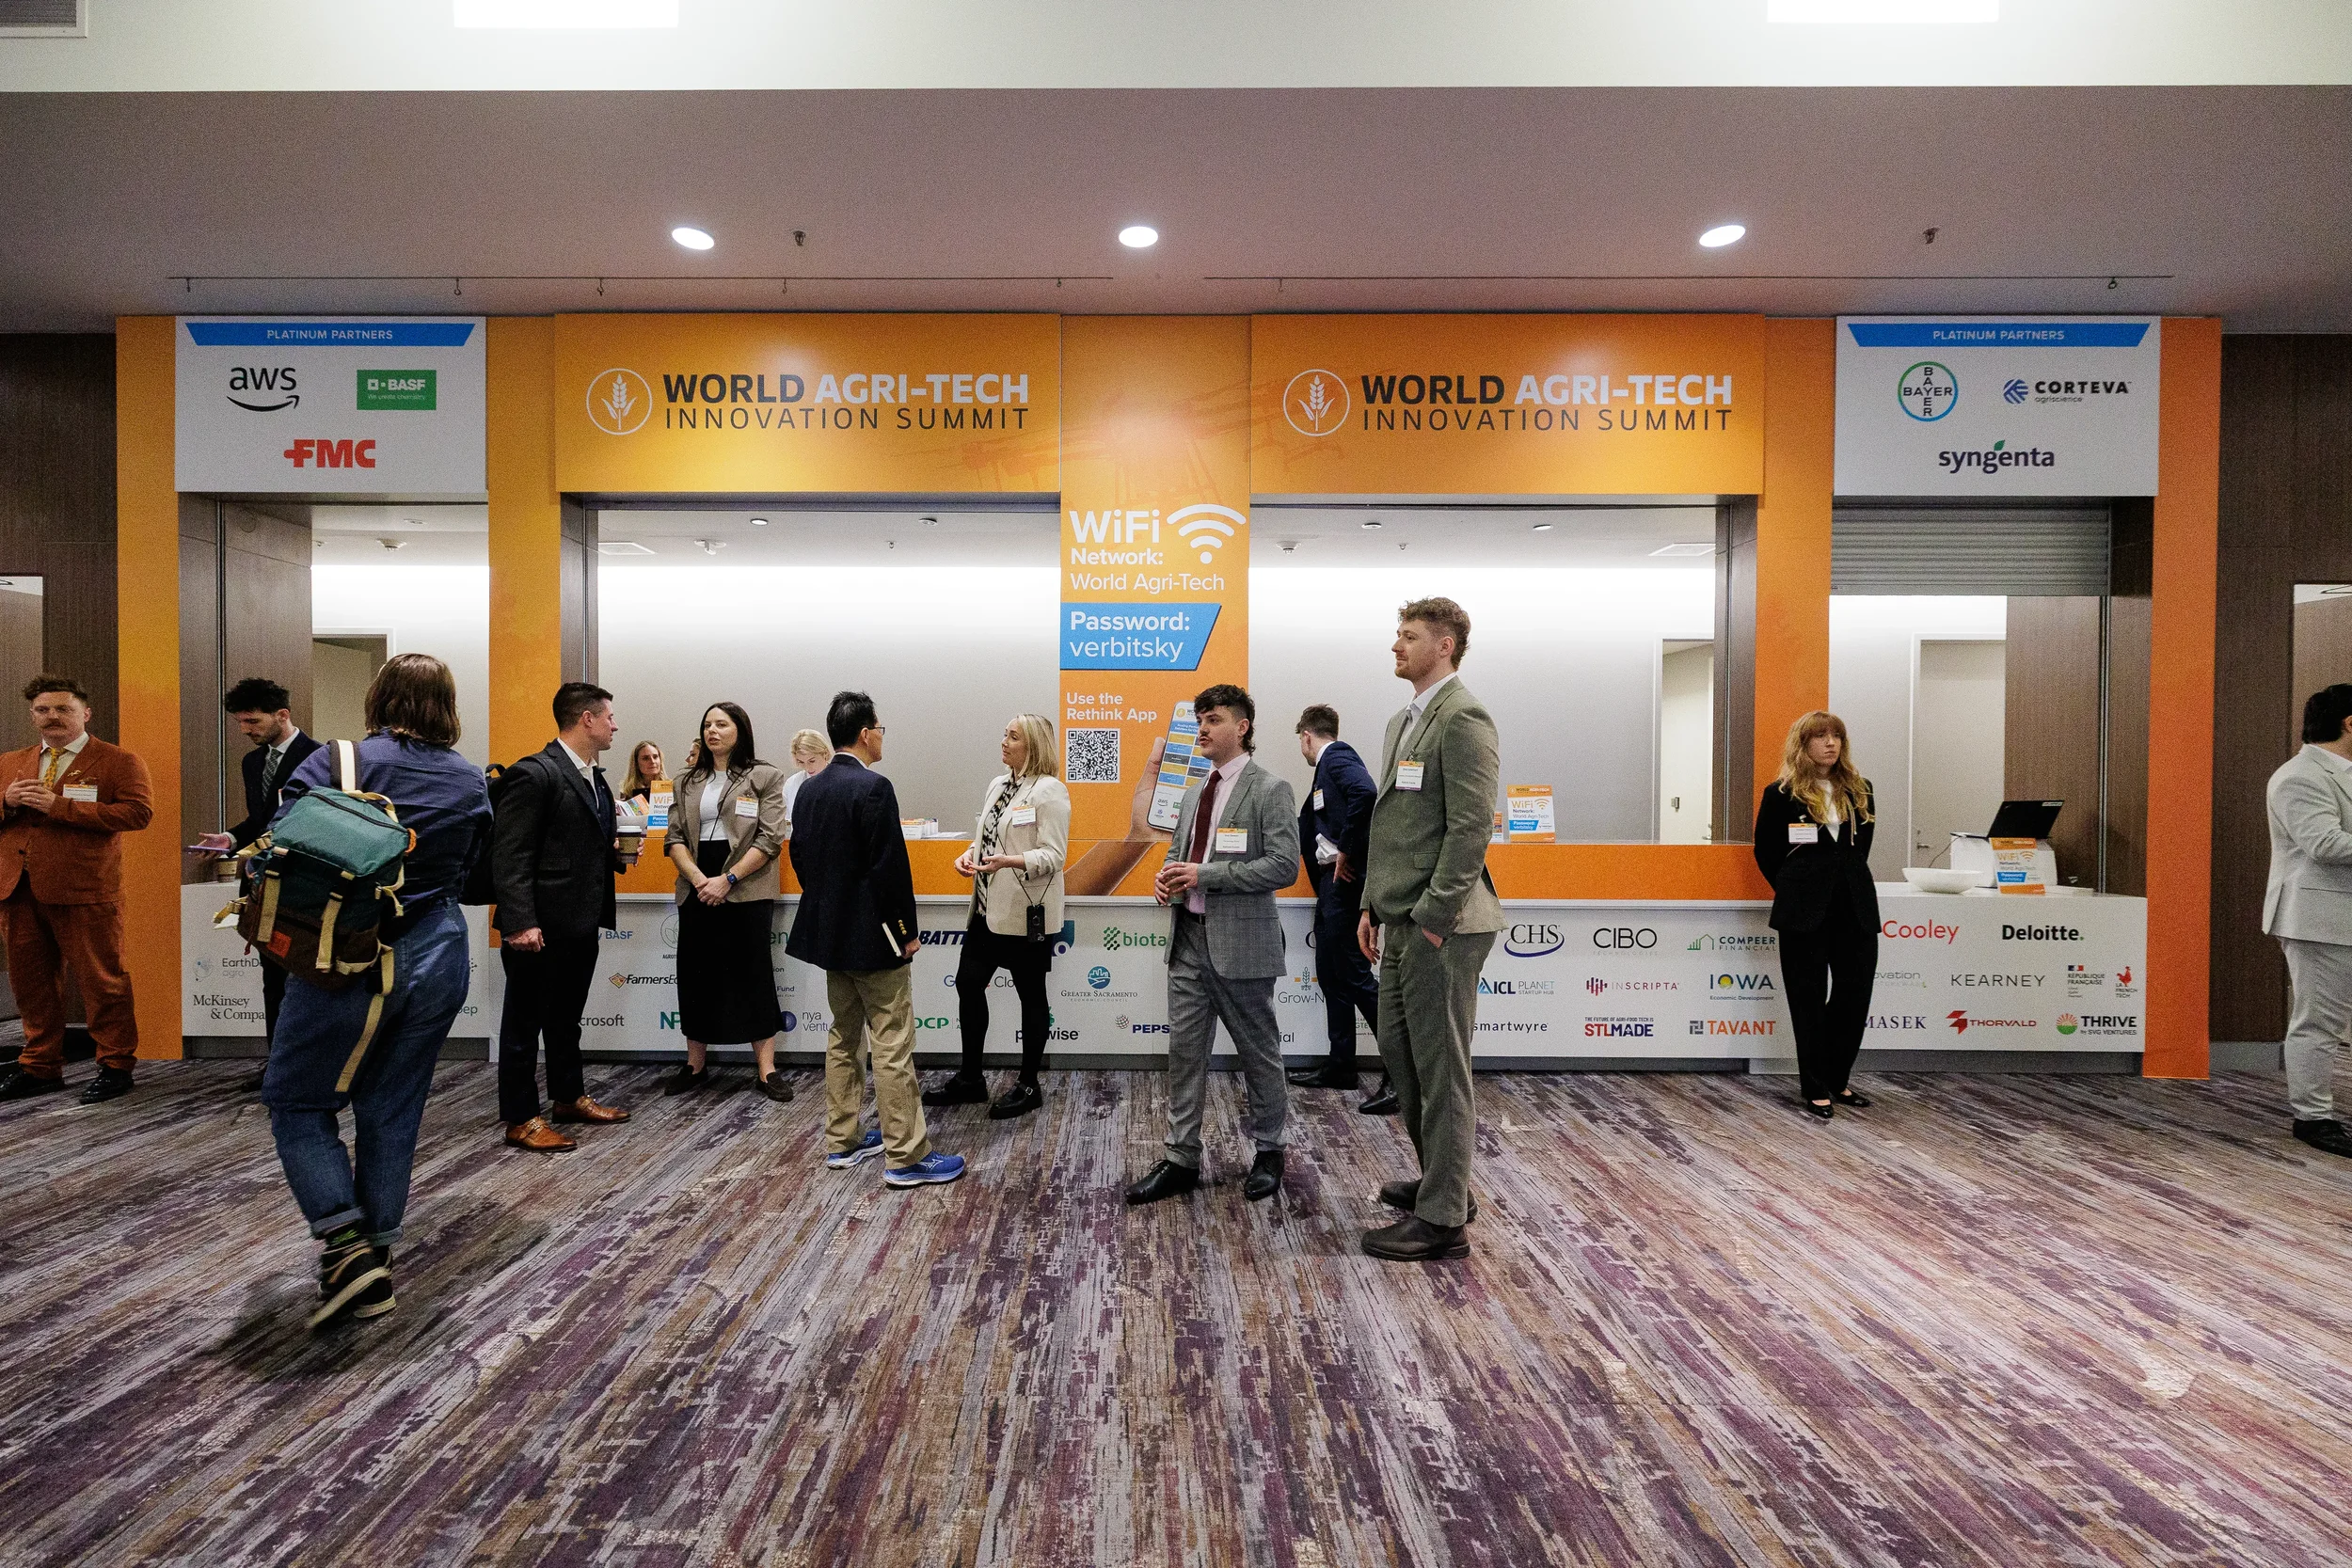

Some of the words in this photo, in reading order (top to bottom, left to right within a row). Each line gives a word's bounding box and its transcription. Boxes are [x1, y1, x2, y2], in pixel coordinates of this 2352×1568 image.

[267, 329, 327, 340] PLATINUM
[331, 329, 393, 340] PARTNERS
[1933, 330, 1995, 340] PLATINUM
[2000, 330, 2065, 340] PARTNERS
[229, 367, 297, 391] aws
[388, 379, 426, 390] BASF
[663, 373, 804, 404] WORLD
[815, 373, 1028, 404] AGRI-TECH
[1361, 374, 1505, 404] WORLD
[1515, 374, 1732, 404] AGRI-TECH
[1903, 387, 1953, 396] BAYER
[2035, 381, 2129, 394] CORTEVA
[666, 407, 879, 429] INNOVATION
[897, 407, 1029, 429] SUMMIT
[1364, 409, 1580, 431] INNOVATION
[1598, 409, 1732, 431] SUMMIT
[284, 439, 375, 468] FMC
[1938, 447, 2055, 473] syngenta
[1069, 510, 1160, 544] WiFi
[1071, 548, 1163, 565] Network:
[1071, 573, 1127, 591] World
[1134, 573, 1225, 594] Agri-Tech
[1071, 611, 1190, 631] Password:
[1070, 638, 1184, 662] verbitsky
[1066, 692, 1095, 705] Use
[1100, 692, 1123, 705] the
[1066, 707, 1122, 721] Rethink
[1127, 707, 1157, 724] App
[606, 931, 633, 940] BASF
[1123, 932, 1167, 946] biota
[1511, 925, 1559, 943] CHS
[1594, 928, 1658, 948] CIBO
[1882, 920, 1959, 944] Cooley
[2002, 925, 2084, 941] Deloitte.
[1720, 936, 1776, 944] COMPEER
[223, 970, 245, 978] agro
[1951, 974, 2045, 987] KEARNEY
[1494, 981, 1516, 994] ICL
[1518, 981, 1555, 990] PLANET
[1710, 974, 1775, 990] IOWA
[193, 995, 250, 1008] McKinsey
[1278, 991, 1325, 1004] Grow-N
[211, 1008, 222, 1020] &
[224, 1008, 265, 1022] Compa
[803, 1012, 821, 1022] nya
[2081, 1016, 2137, 1027] THRIVE
[1473, 1022, 1548, 1033] smartwyre
[1584, 1023, 1654, 1037] STLMADE
[1708, 1021, 1776, 1035] TAVANT
